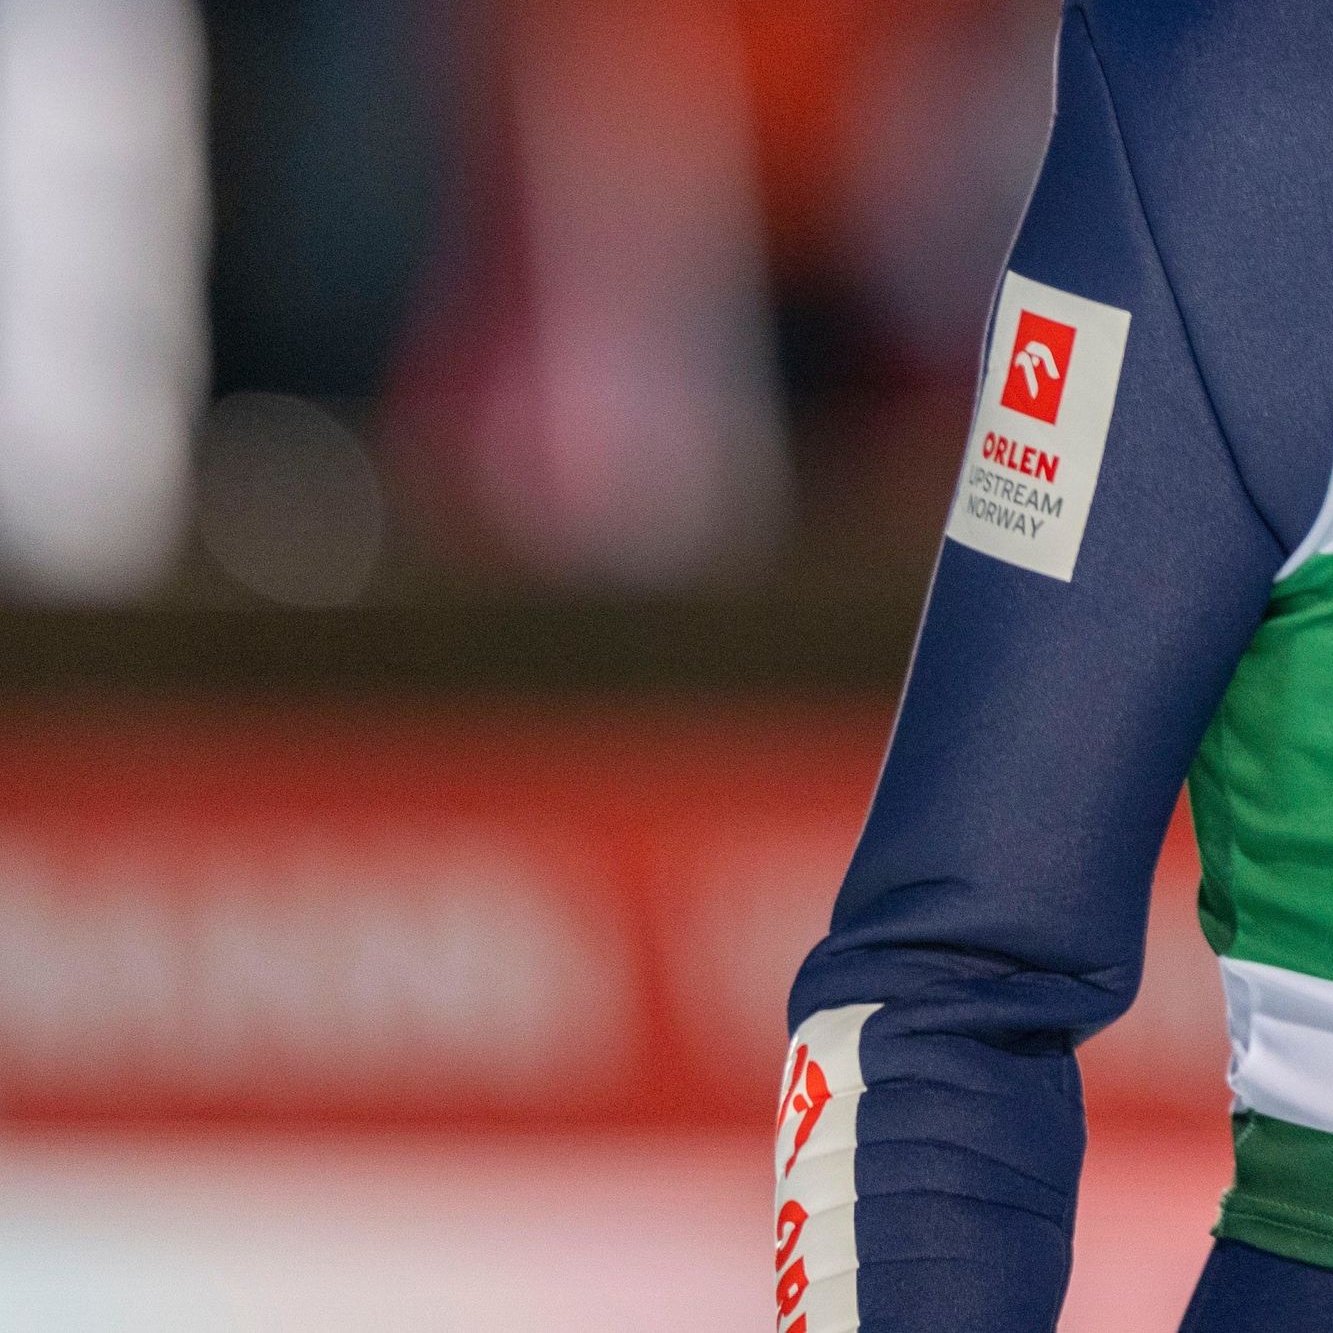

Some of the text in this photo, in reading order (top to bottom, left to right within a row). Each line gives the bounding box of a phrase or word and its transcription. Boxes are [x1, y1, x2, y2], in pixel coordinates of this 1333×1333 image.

[982, 430, 1060, 484] ORLEN
[967, 493, 1045, 539] NORWAY
[968, 464, 1064, 519] UPSTREAM
